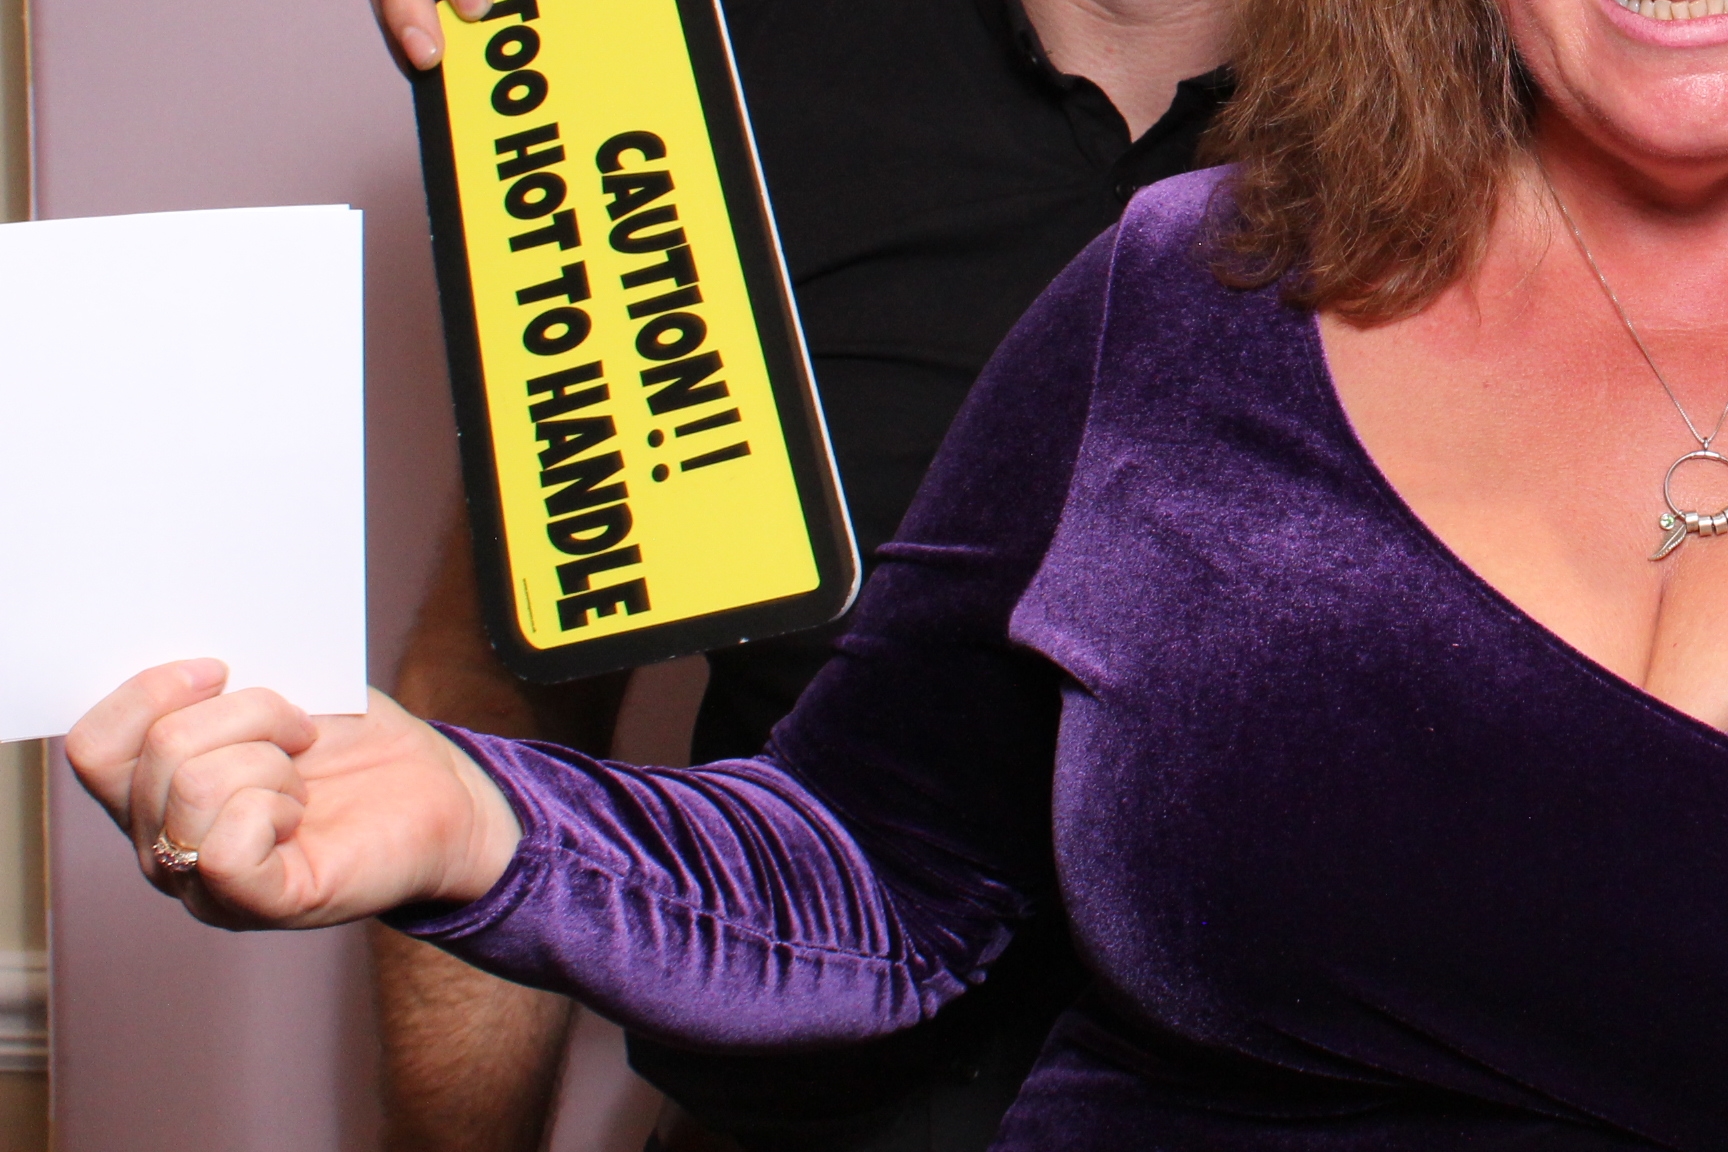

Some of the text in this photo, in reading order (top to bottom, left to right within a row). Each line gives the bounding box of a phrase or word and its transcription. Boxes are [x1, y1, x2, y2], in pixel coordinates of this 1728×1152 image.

[493, 121, 582, 253] HOT
[515, 260, 593, 357] TO
[594, 129, 751, 484] CAUTION!!
[525, 359, 652, 633] HANDLE
